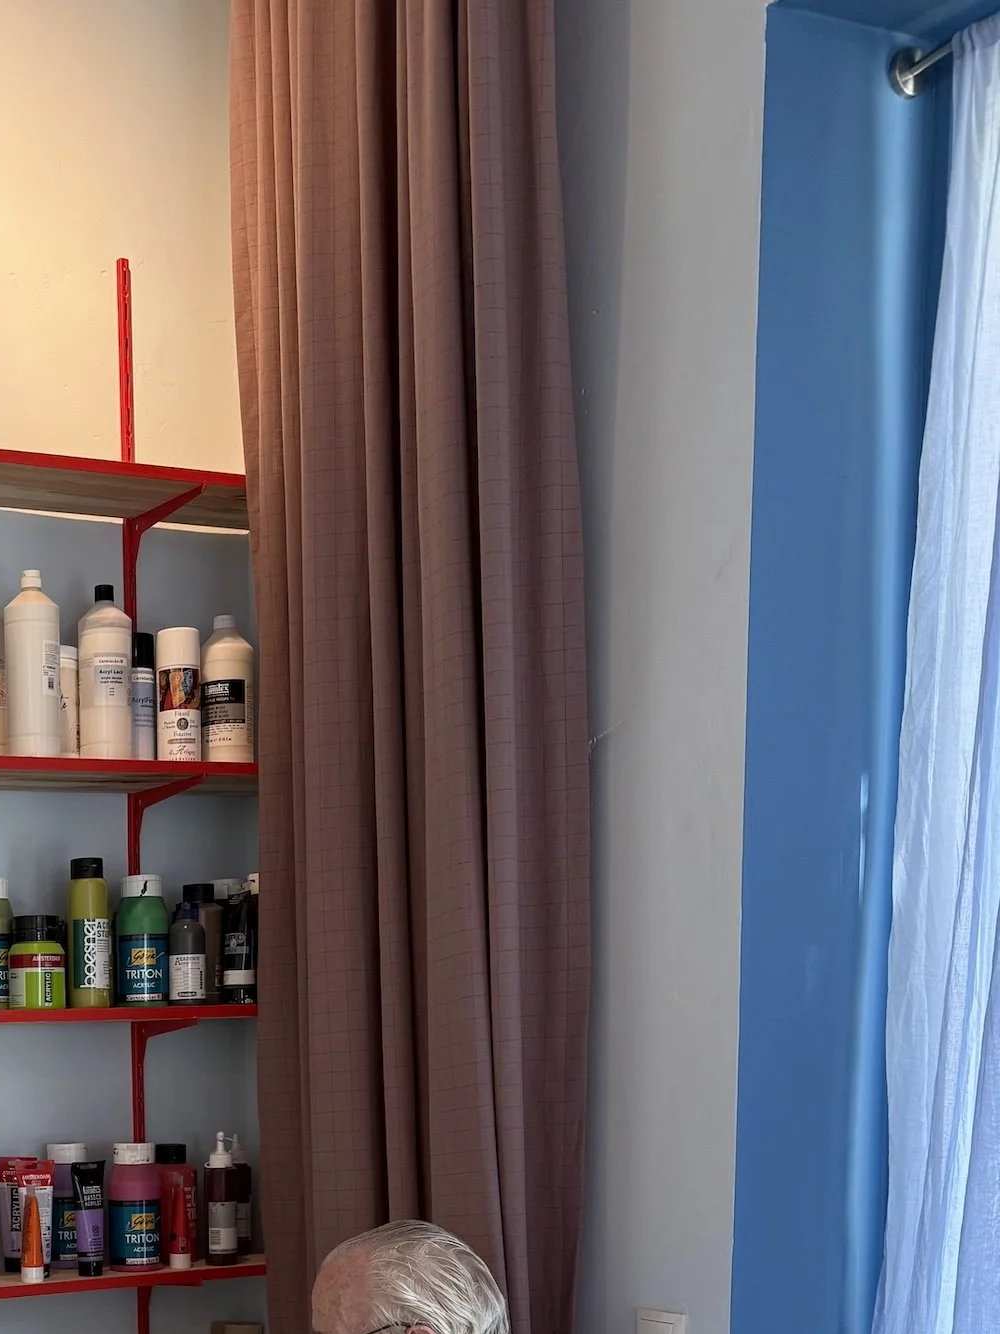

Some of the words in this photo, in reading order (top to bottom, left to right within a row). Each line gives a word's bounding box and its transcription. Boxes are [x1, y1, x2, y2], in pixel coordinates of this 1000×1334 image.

[80, 919, 96, 989] boesner
[125, 968, 163, 981] TRITON
[84, 1193, 102, 1201] BASICS
[11, 1188, 21, 1230] ACRYLIC
[125, 1231, 161, 1245] TRITON
